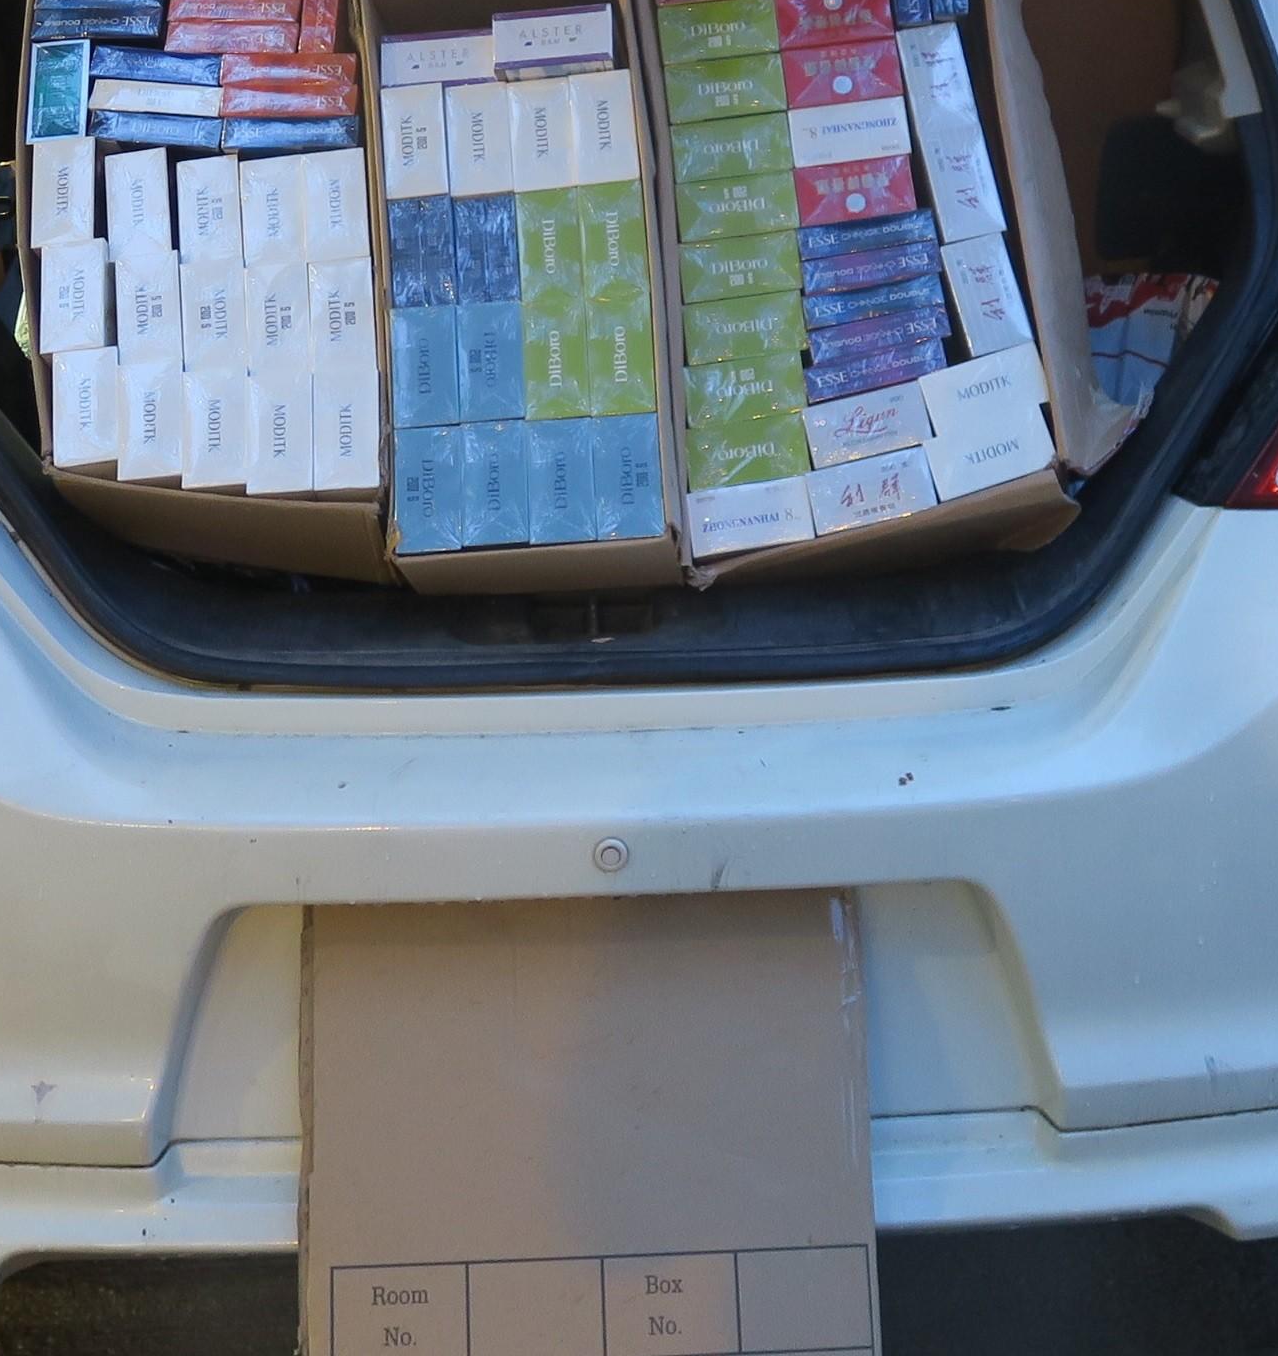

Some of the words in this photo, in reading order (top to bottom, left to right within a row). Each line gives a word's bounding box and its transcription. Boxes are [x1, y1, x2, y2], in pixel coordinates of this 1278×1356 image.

[122, 15, 151, 26] ESSE
[519, 25, 582, 38] ALSTER
[814, 299, 846, 318] ESSE
[371, 1284, 429, 1307] Room
[645, 1275, 683, 1296] Box
[648, 1315, 682, 1337] No.
[383, 1326, 417, 1348] No.
